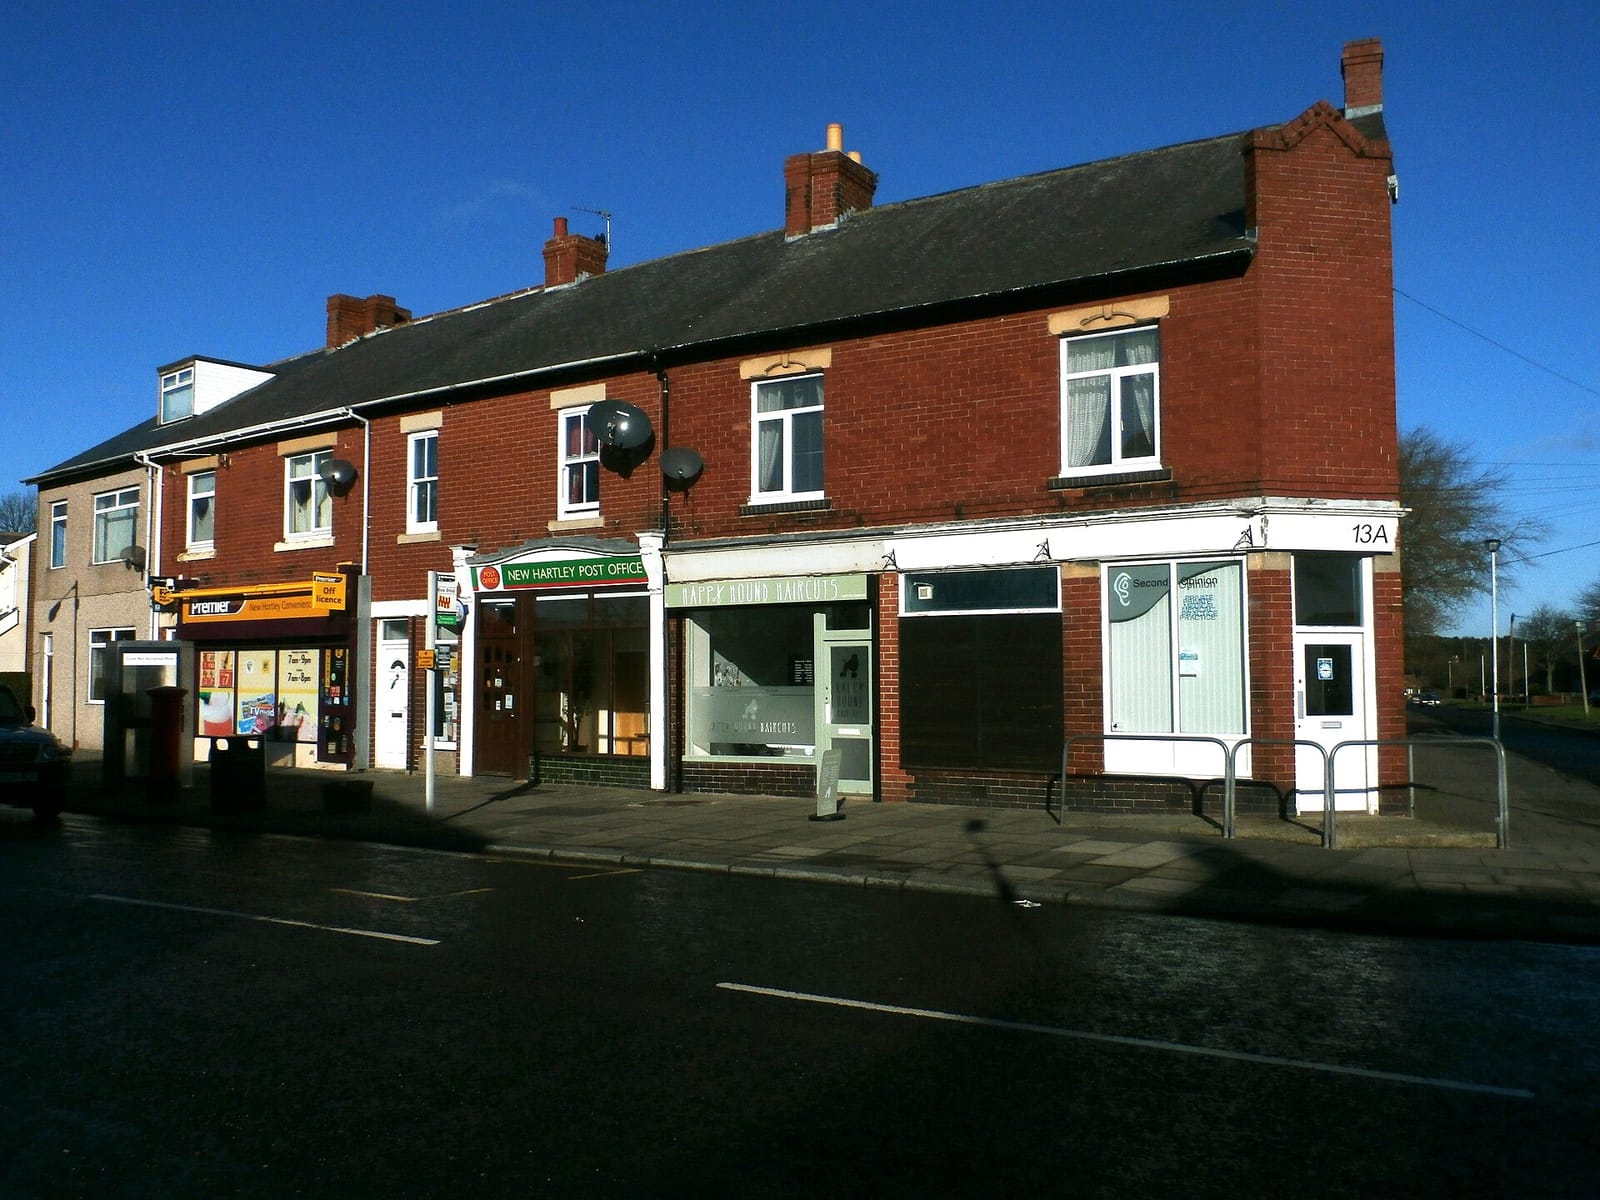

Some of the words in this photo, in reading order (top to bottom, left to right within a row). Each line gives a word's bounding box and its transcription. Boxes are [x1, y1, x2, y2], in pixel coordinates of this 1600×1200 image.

[1352, 524, 1389, 544] 13A
[508, 569, 530, 581] NEW
[532, 566, 576, 580] HARTLEY
[579, 564, 604, 577] POST
[607, 561, 643, 575] OFFICE
[1133, 578, 1169, 588] Second
[1181, 576, 1218, 589] Opinion
[323, 587, 337, 595] Off
[682, 585, 725, 607] HAPPY
[729, 582, 769, 604] HOUND
[776, 578, 839, 602] HAIRCUTS
[316, 595, 343, 604] licence
[191, 600, 231, 615] Premier
[759, 721, 797, 734] HAIRCUTS
